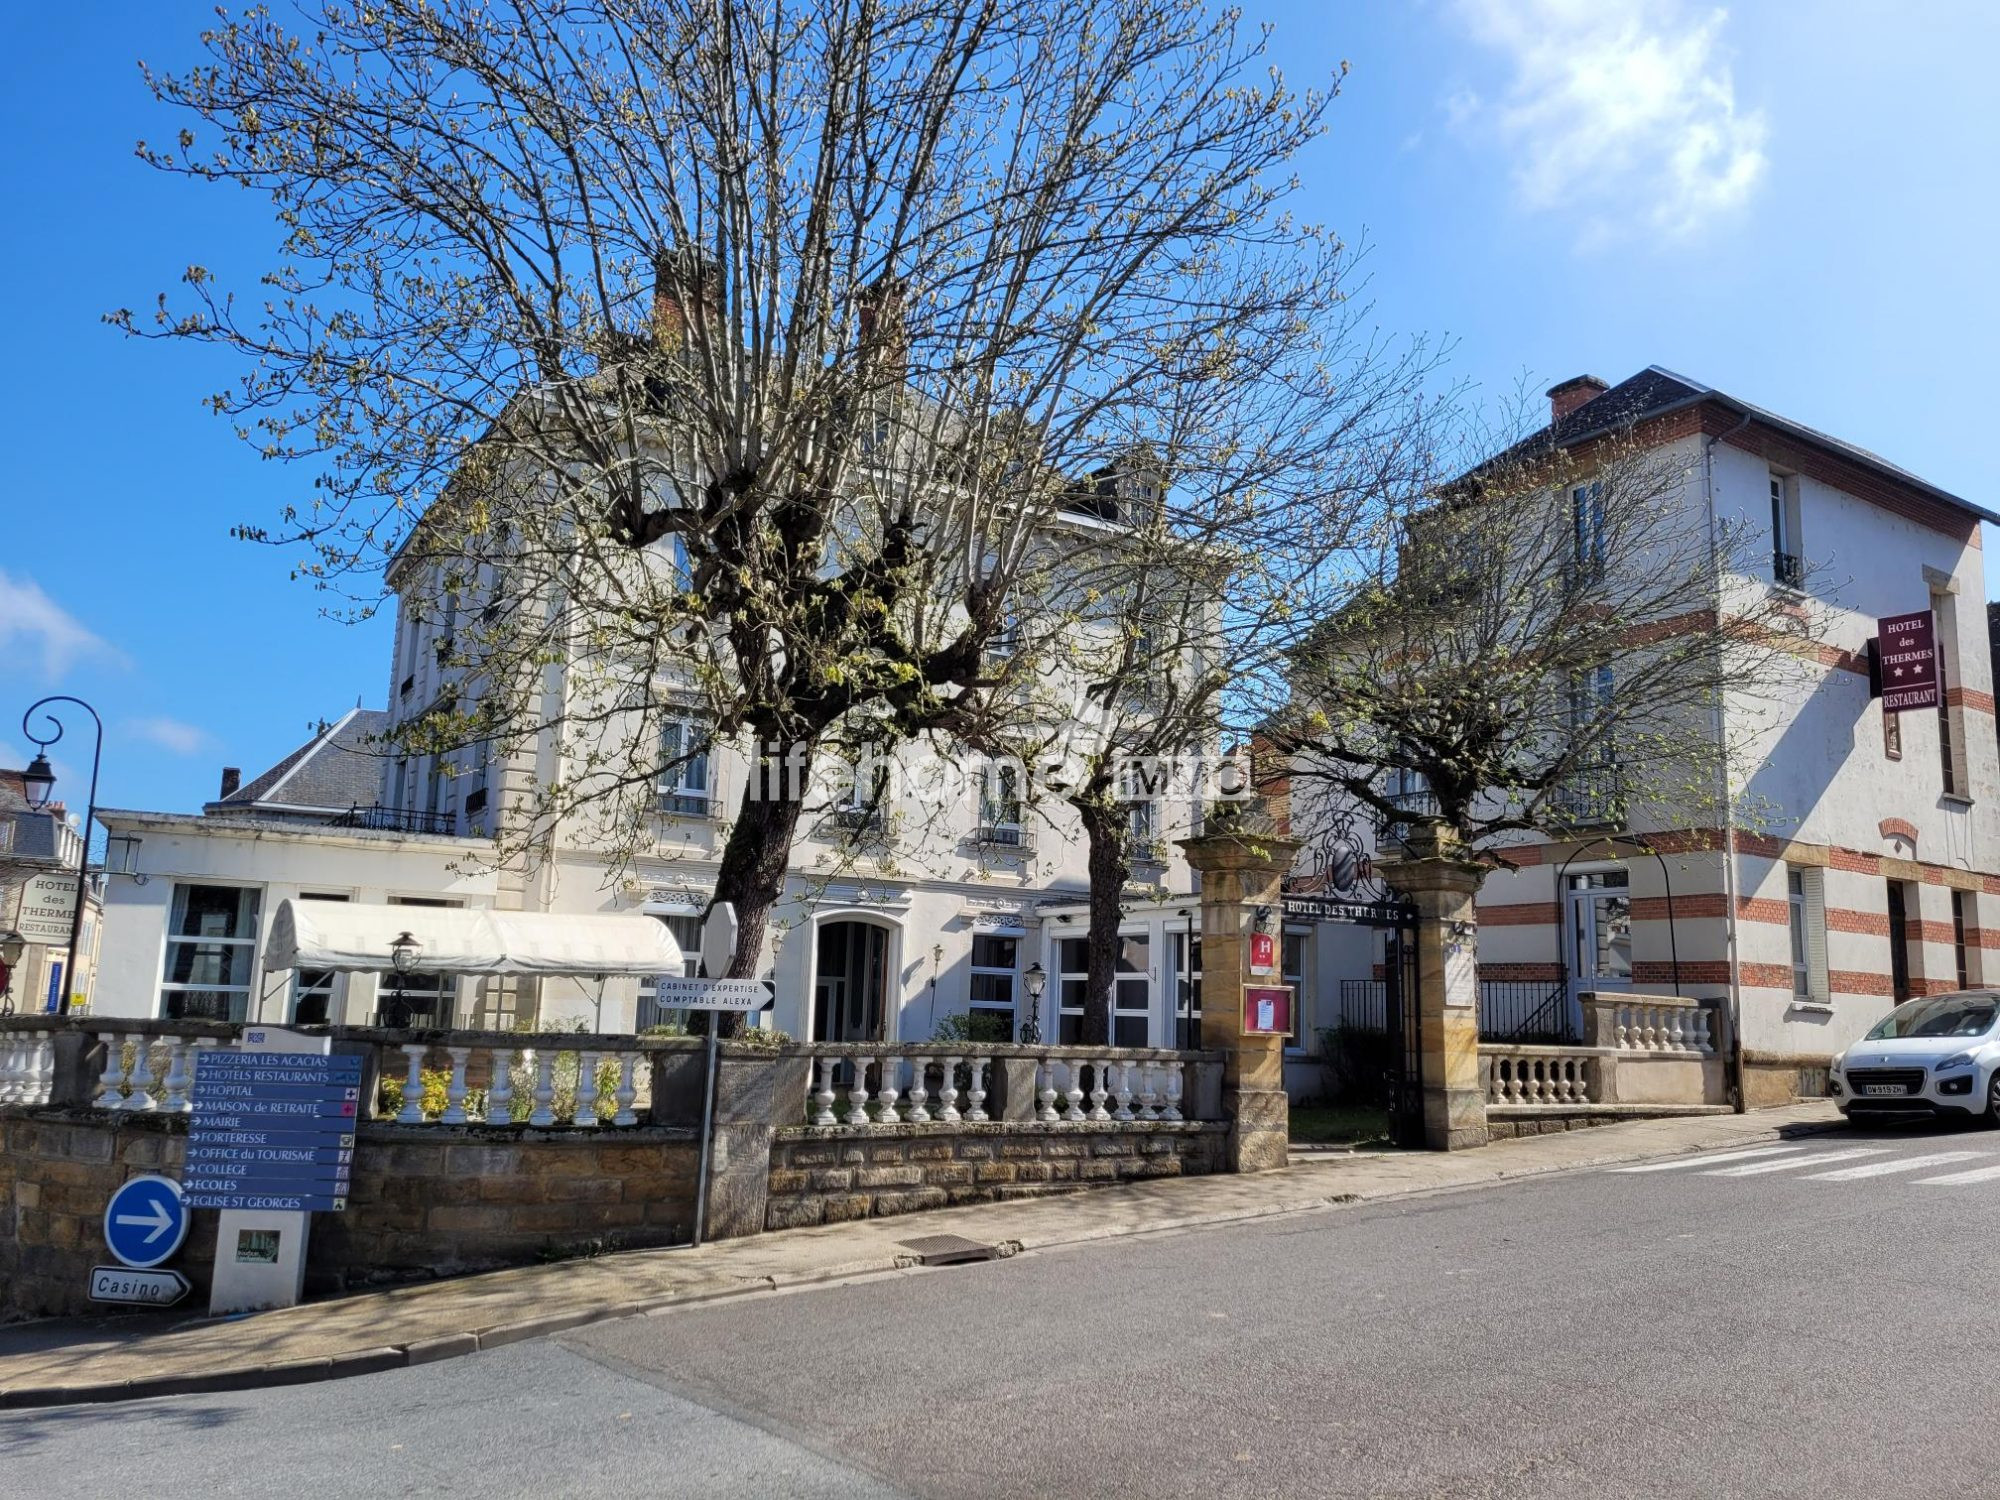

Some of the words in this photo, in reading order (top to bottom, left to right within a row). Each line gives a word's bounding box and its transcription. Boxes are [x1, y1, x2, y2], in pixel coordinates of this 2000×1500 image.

[1888, 620, 1924, 634] HOTEL
[1899, 637, 1915, 647] des
[1882, 649, 1933, 665] THERMES
[1884, 689, 1936, 708] RESTAURANT
[35, 880, 78, 892] HOTEL
[43, 895, 65, 905] des
[22, 906, 76, 919] THERME
[1288, 901, 1321, 914] HOTEL
[1324, 904, 1345, 916] DES
[1347, 905, 1399, 920] THERES
[19, 922, 73, 934] RESTAURAN
[1261, 941, 1270, 953] H
[661, 983, 698, 991] CABINET
[703, 984, 758, 993] D'EXPERTISE
[660, 995, 716, 1004] COMPTABLE
[723, 997, 752, 1005] ALEXA
[211, 1056, 258, 1065] PIZZERIA
[261, 1057, 278, 1065] LES
[280, 1057, 328, 1066] ACACIAS
[208, 1070, 251, 1080] HOTELS
[254, 1072, 329, 1082] RESTAURANTS
[206, 1086, 254, 1095] HOPITAL
[205, 1102, 250, 1112] MAISON
[254, 1103, 267, 1112] de
[270, 1103, 319, 1114] RETRAITE
[203, 1117, 241, 1127] MAIRIE
[201, 1132, 267, 1143] FORTERESSE
[200, 1148, 238, 1159] OFFICE
[240, 1150, 254, 1159] du
[258, 1150, 315, 1160] TOURISME
[197, 1164, 247, 1175] COLLEGE
[194, 1180, 237, 1190] ECOLES
[193, 1196, 229, 1207] EGLISE
[231, 1197, 245, 1207] ST
[248, 1197, 300, 1208] GEORGES
[98, 1277, 160, 1296] Casino
